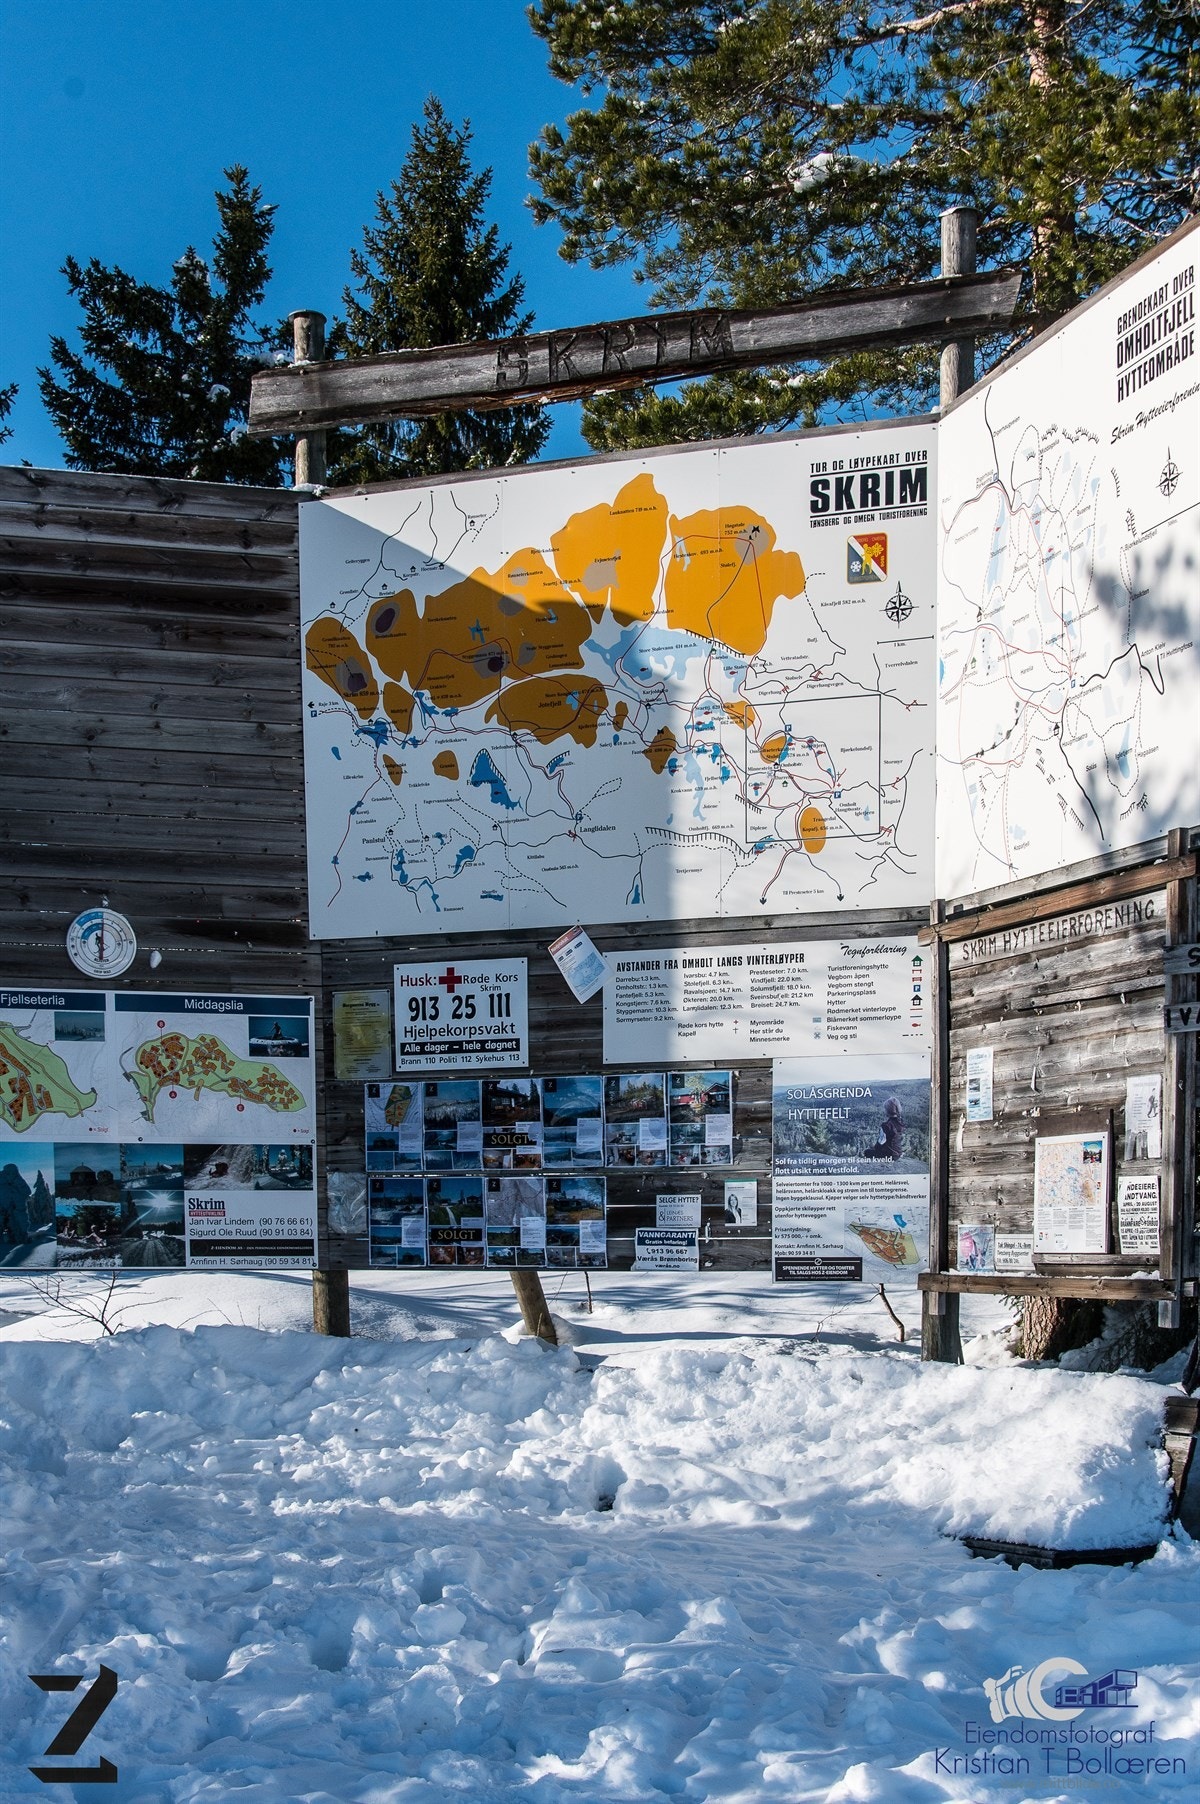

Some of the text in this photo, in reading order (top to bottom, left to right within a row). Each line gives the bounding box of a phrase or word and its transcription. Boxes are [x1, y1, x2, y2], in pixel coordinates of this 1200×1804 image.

[1117, 265, 1194, 335] GRENDEKART OVER
[1116, 292, 1195, 369] OMHOLTFJELL
[496, 313, 733, 386] SKRIM
[1117, 330, 1195, 403] HYTTEOMRÅDE
[1111, 423, 1135, 445] Skrim
[810, 449, 928, 473] TUR OG LØYPEKART OVER
[810, 467, 928, 514] SKRIM
[810, 508, 928, 528] TØNSBERG OG OMEGN TURISTFORENING
[962, 899, 1155, 961] SKRIM HYTTEEIERFORENING
[840, 944, 907, 959] Tegnforklaring
[616, 954, 805, 972] AVSTANDER FRA OMHOLT LANGS VINTERLØYPER
[828, 964, 889, 972] Turistforeningshytte
[400, 973, 519, 987] Husk: Røde Kors
[480, 984, 502, 992] Skrim
[827, 989, 876, 997] Parkeringsplass
[1, 994, 65, 1006] Fjellseterlia
[185, 998, 244, 1012] Middagslia
[408, 995, 440, 1022] 913
[451, 994, 476, 1020] 25
[488, 992, 511, 1018] 111
[404, 1022, 516, 1041] Hjelpekorpsvakt
[404, 1040, 517, 1054] Alle dager hele døgnet
[401, 1057, 421, 1065] Brann
[439, 1056, 458, 1064] Politi
[476, 1054, 505, 1064] Sykehus
[787, 1086, 872, 1100] SOLÅSGRENDA
[788, 1107, 851, 1120] HYTTEFELT
[491, 1134, 529, 1145] SOLGT
[188, 1198, 225, 1210] Skrim
[189, 1218, 205, 1226] Jan
[207, 1218, 221, 1226] Ivar
[260, 1217, 273, 1227] (90
[300, 1217, 313, 1227] 61)
[189, 1229, 216, 1238] Sigurd
[260, 1228, 273, 1237] (90
[300, 1228, 313, 1237] 84)
[437, 1229, 476, 1240] SOLGT
[230, 1258, 263, 1266] Sørhaug
[265, 1257, 277, 1266] (90
